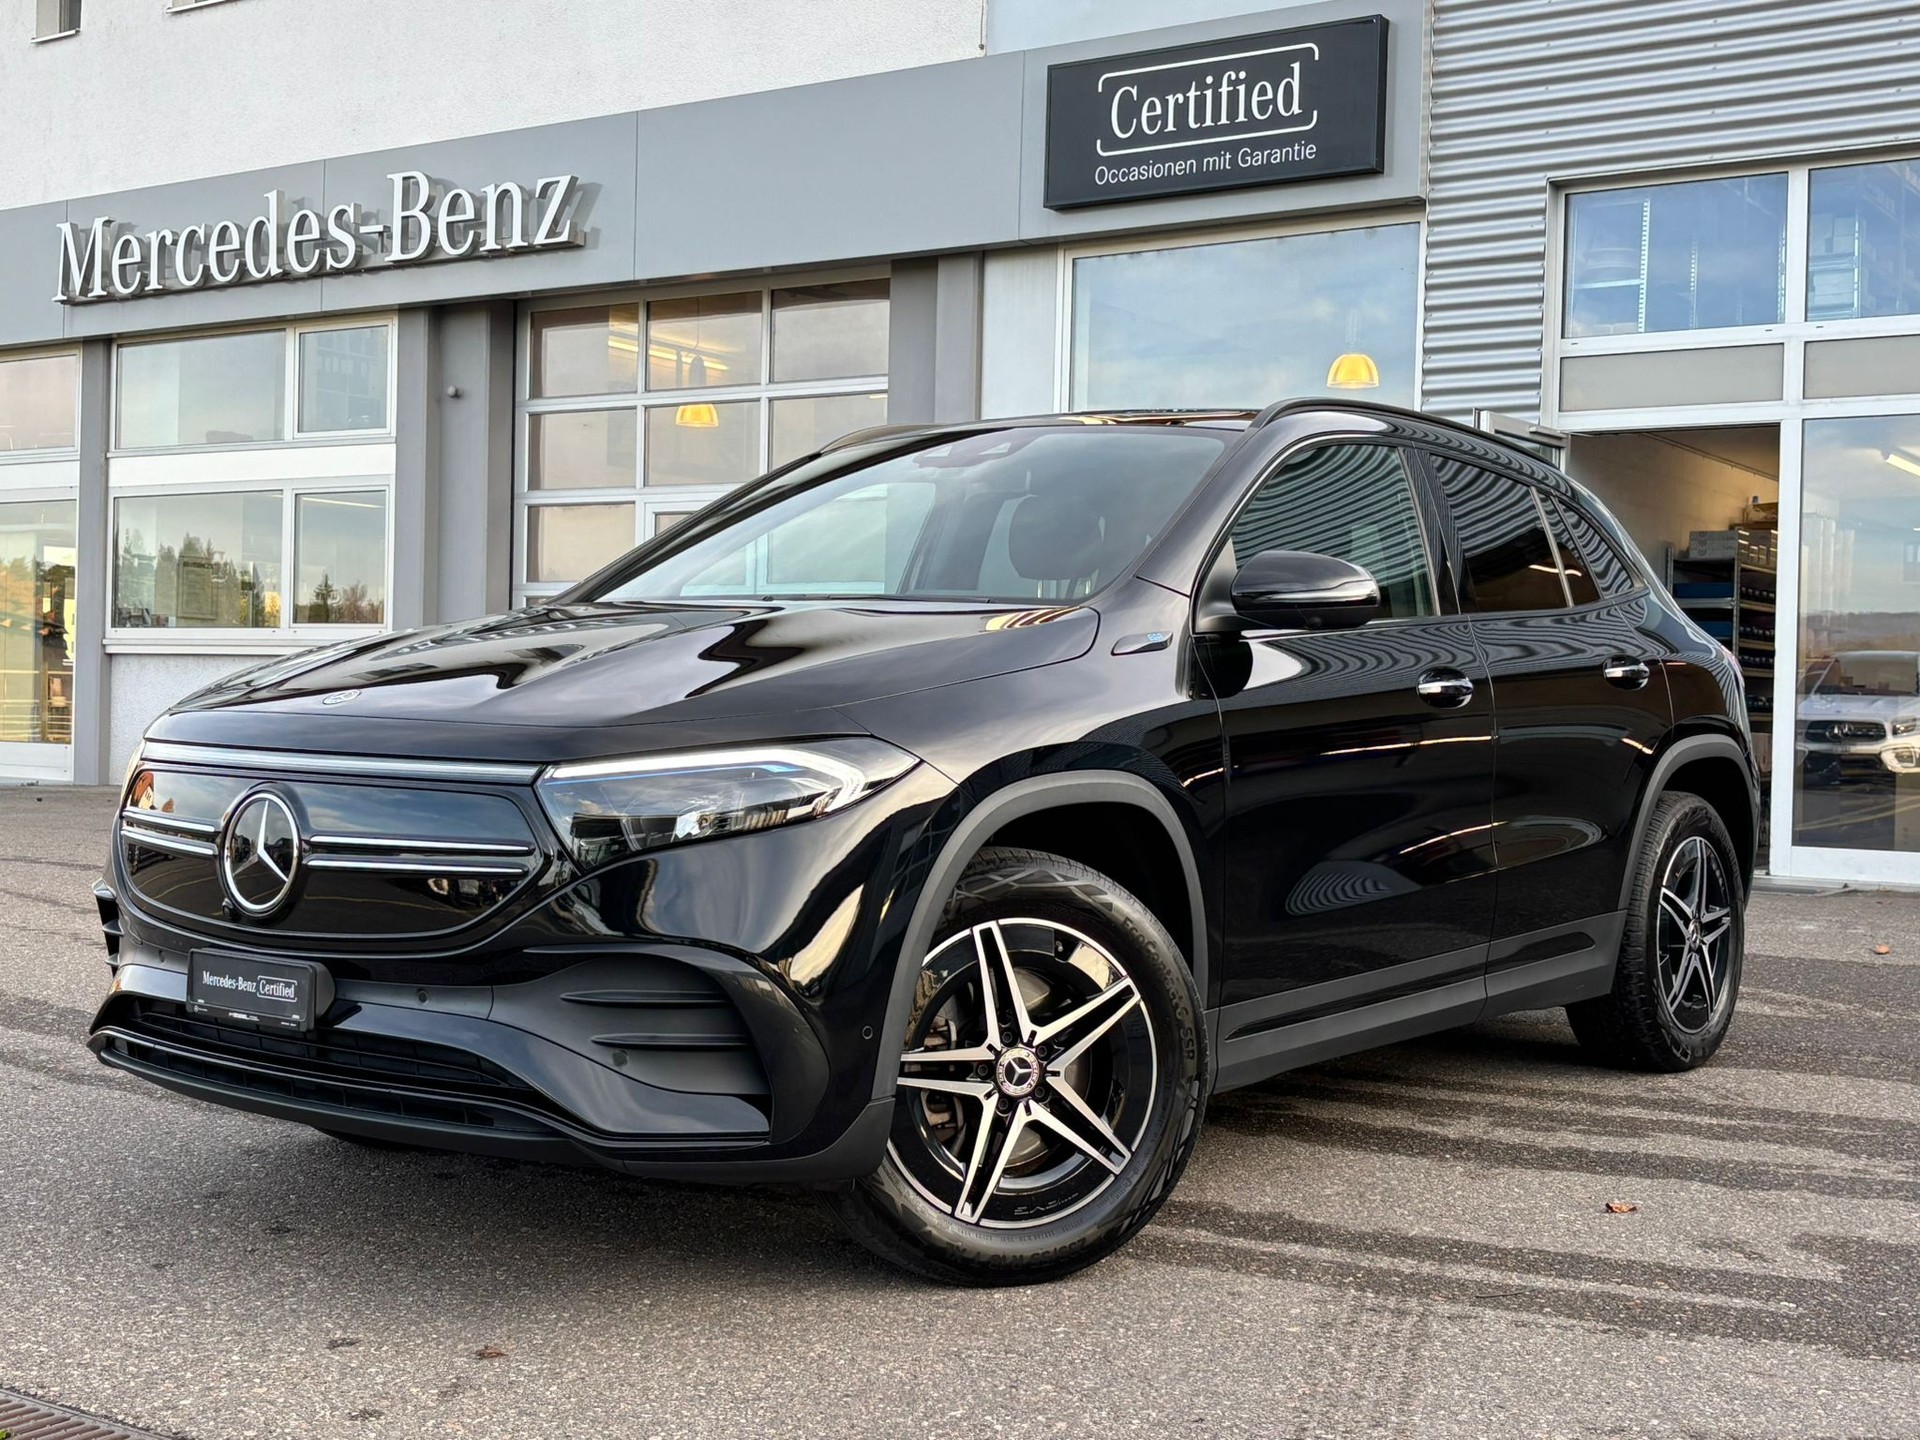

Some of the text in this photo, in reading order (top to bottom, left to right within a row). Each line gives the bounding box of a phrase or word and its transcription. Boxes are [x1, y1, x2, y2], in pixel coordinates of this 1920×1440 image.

[1111, 61, 1303, 140] Certified
[1094, 141, 1317, 186] Occasionen mit Garantie
[53, 170, 580, 303] Mercedes-Benz
[202, 970, 296, 998] Mercedes-Benz Certified
